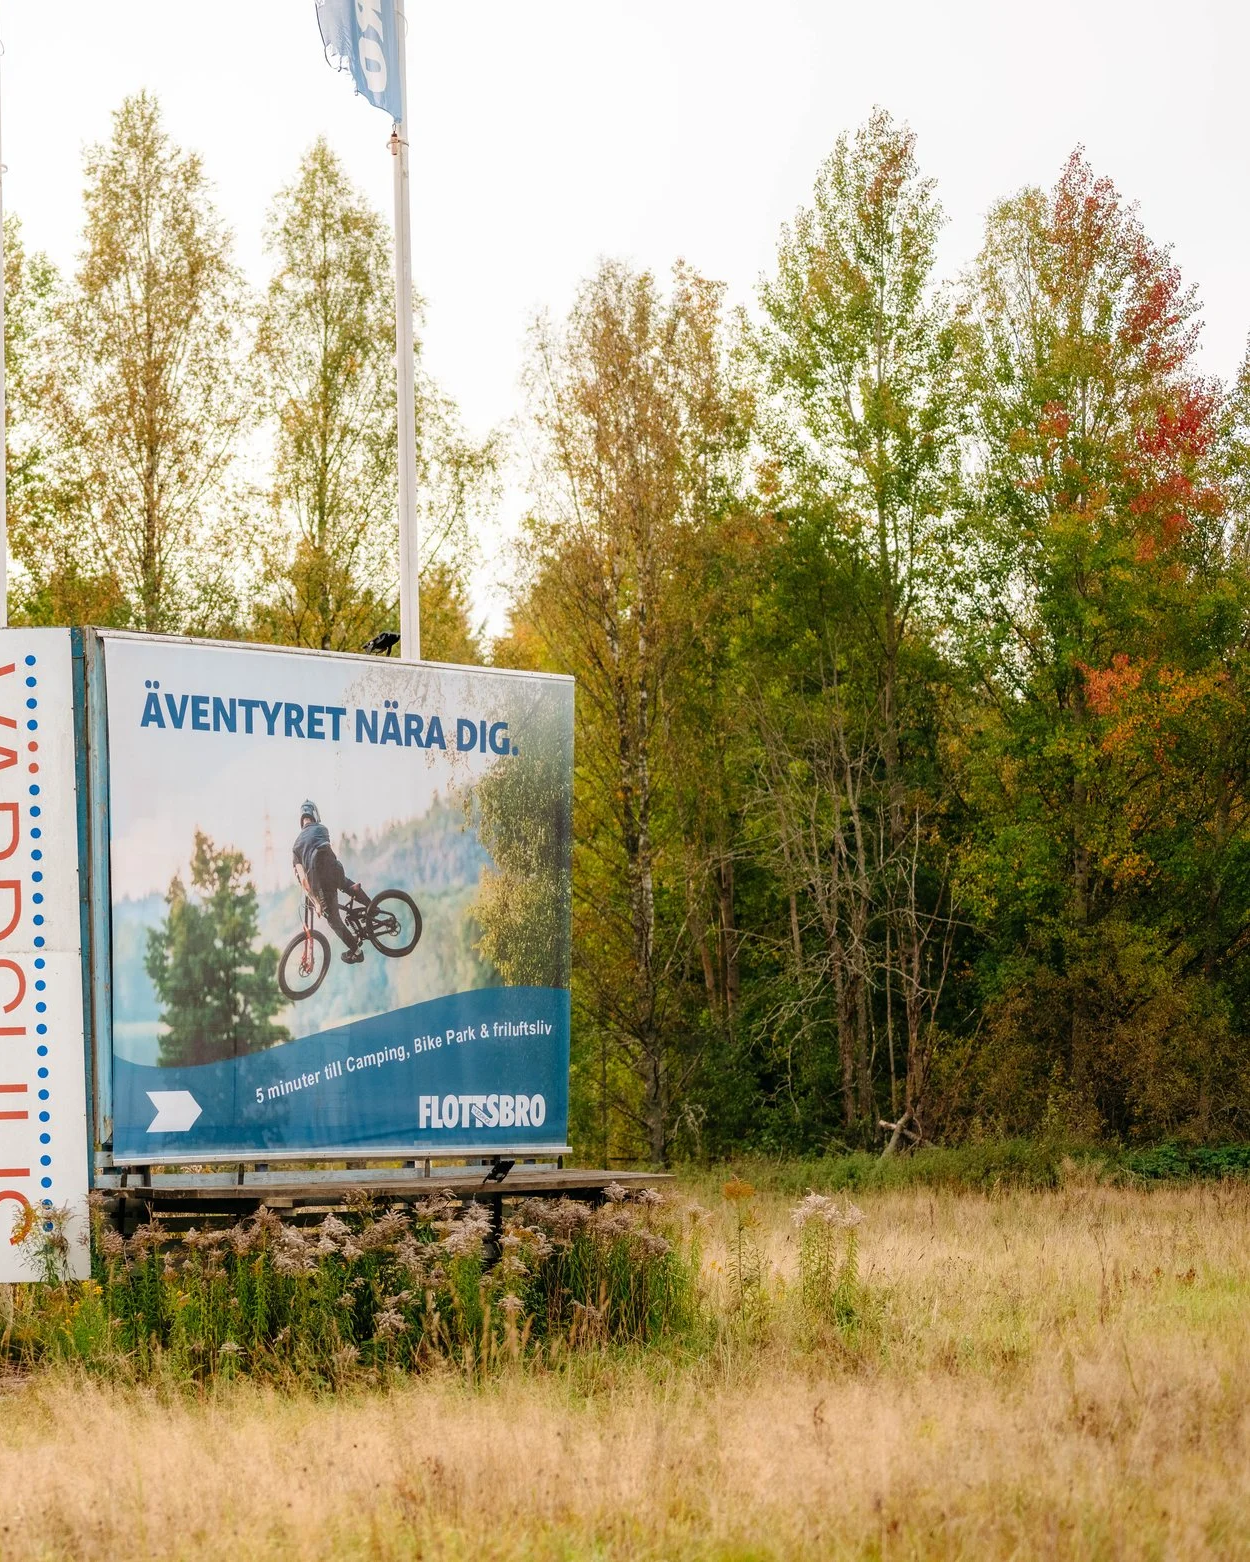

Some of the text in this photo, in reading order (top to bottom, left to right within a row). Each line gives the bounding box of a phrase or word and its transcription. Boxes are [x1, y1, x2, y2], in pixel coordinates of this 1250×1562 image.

[140, 679, 519, 756] ÄVENTYRET NÄRA DIG.
[255, 1020, 552, 1103] 5 minuter till Camping, Bike Park & friluftsliv
[419, 1093, 546, 1129] FLOTTSBRO
